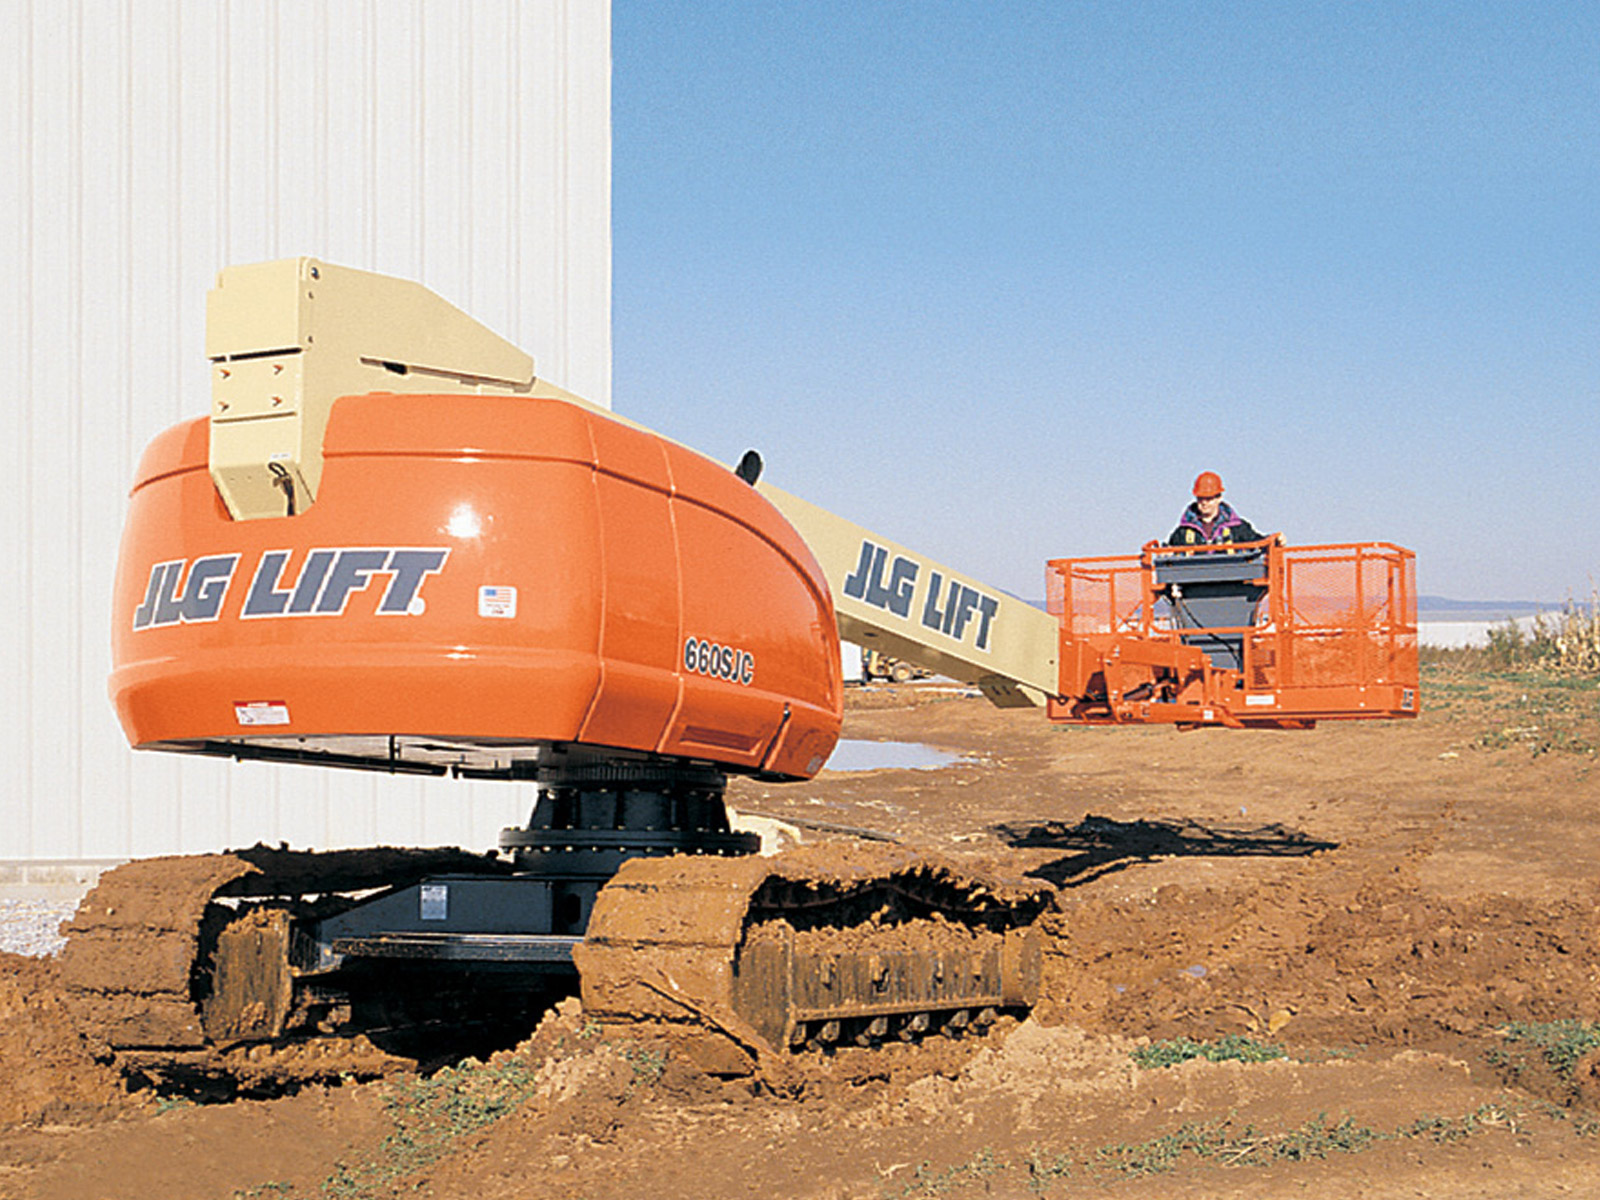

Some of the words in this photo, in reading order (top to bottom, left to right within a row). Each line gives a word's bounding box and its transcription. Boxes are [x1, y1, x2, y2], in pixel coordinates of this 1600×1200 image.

[133, 552, 242, 631] JLG
[843, 538, 920, 621] JLG
[921, 569, 1001, 654] LIFT
[685, 636, 754, 685] 660SJC
